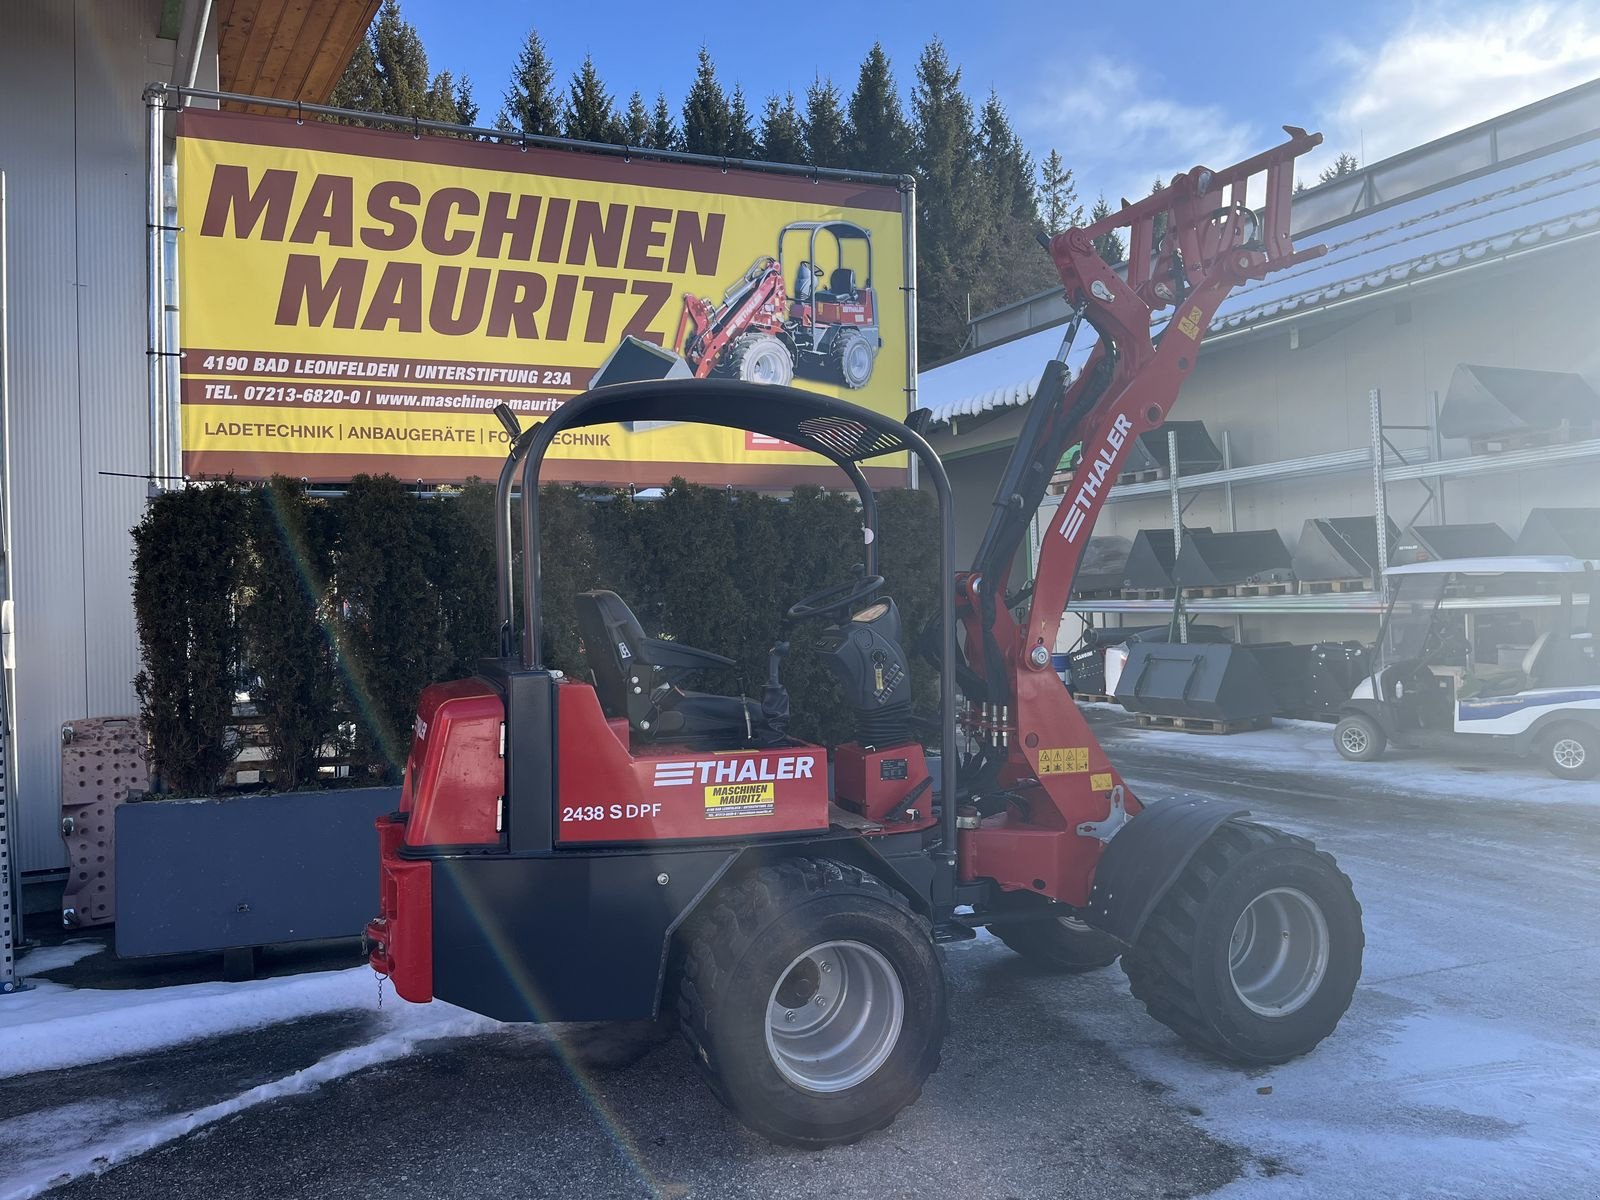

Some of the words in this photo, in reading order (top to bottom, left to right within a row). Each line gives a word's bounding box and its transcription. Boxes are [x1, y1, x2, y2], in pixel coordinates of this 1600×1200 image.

[200, 164, 726, 276] MASCHINEN
[275, 254, 673, 346] MAURITZ
[203, 356, 249, 371] 4190
[253, 357, 289, 373] BAD
[294, 359, 399, 378] LEONFELDEN
[415, 365, 538, 384] UNTERSTIFTUNG
[542, 371, 572, 386] 23A
[205, 384, 238, 400] TEL.
[244, 386, 361, 404] 07213-6820-0
[205, 423, 334, 439] LADETECHNIK
[347, 426, 476, 443] ANBAUGERÄTE
[1074, 413, 1133, 509] THALER
[696, 756, 815, 784] THALER
[713, 784, 768, 797] MASCHINEN
[720, 794, 762, 805] MAURITZ
[562, 806, 605, 822] 2438
[609, 804, 623, 819] S
[626, 803, 662, 818] DPF
